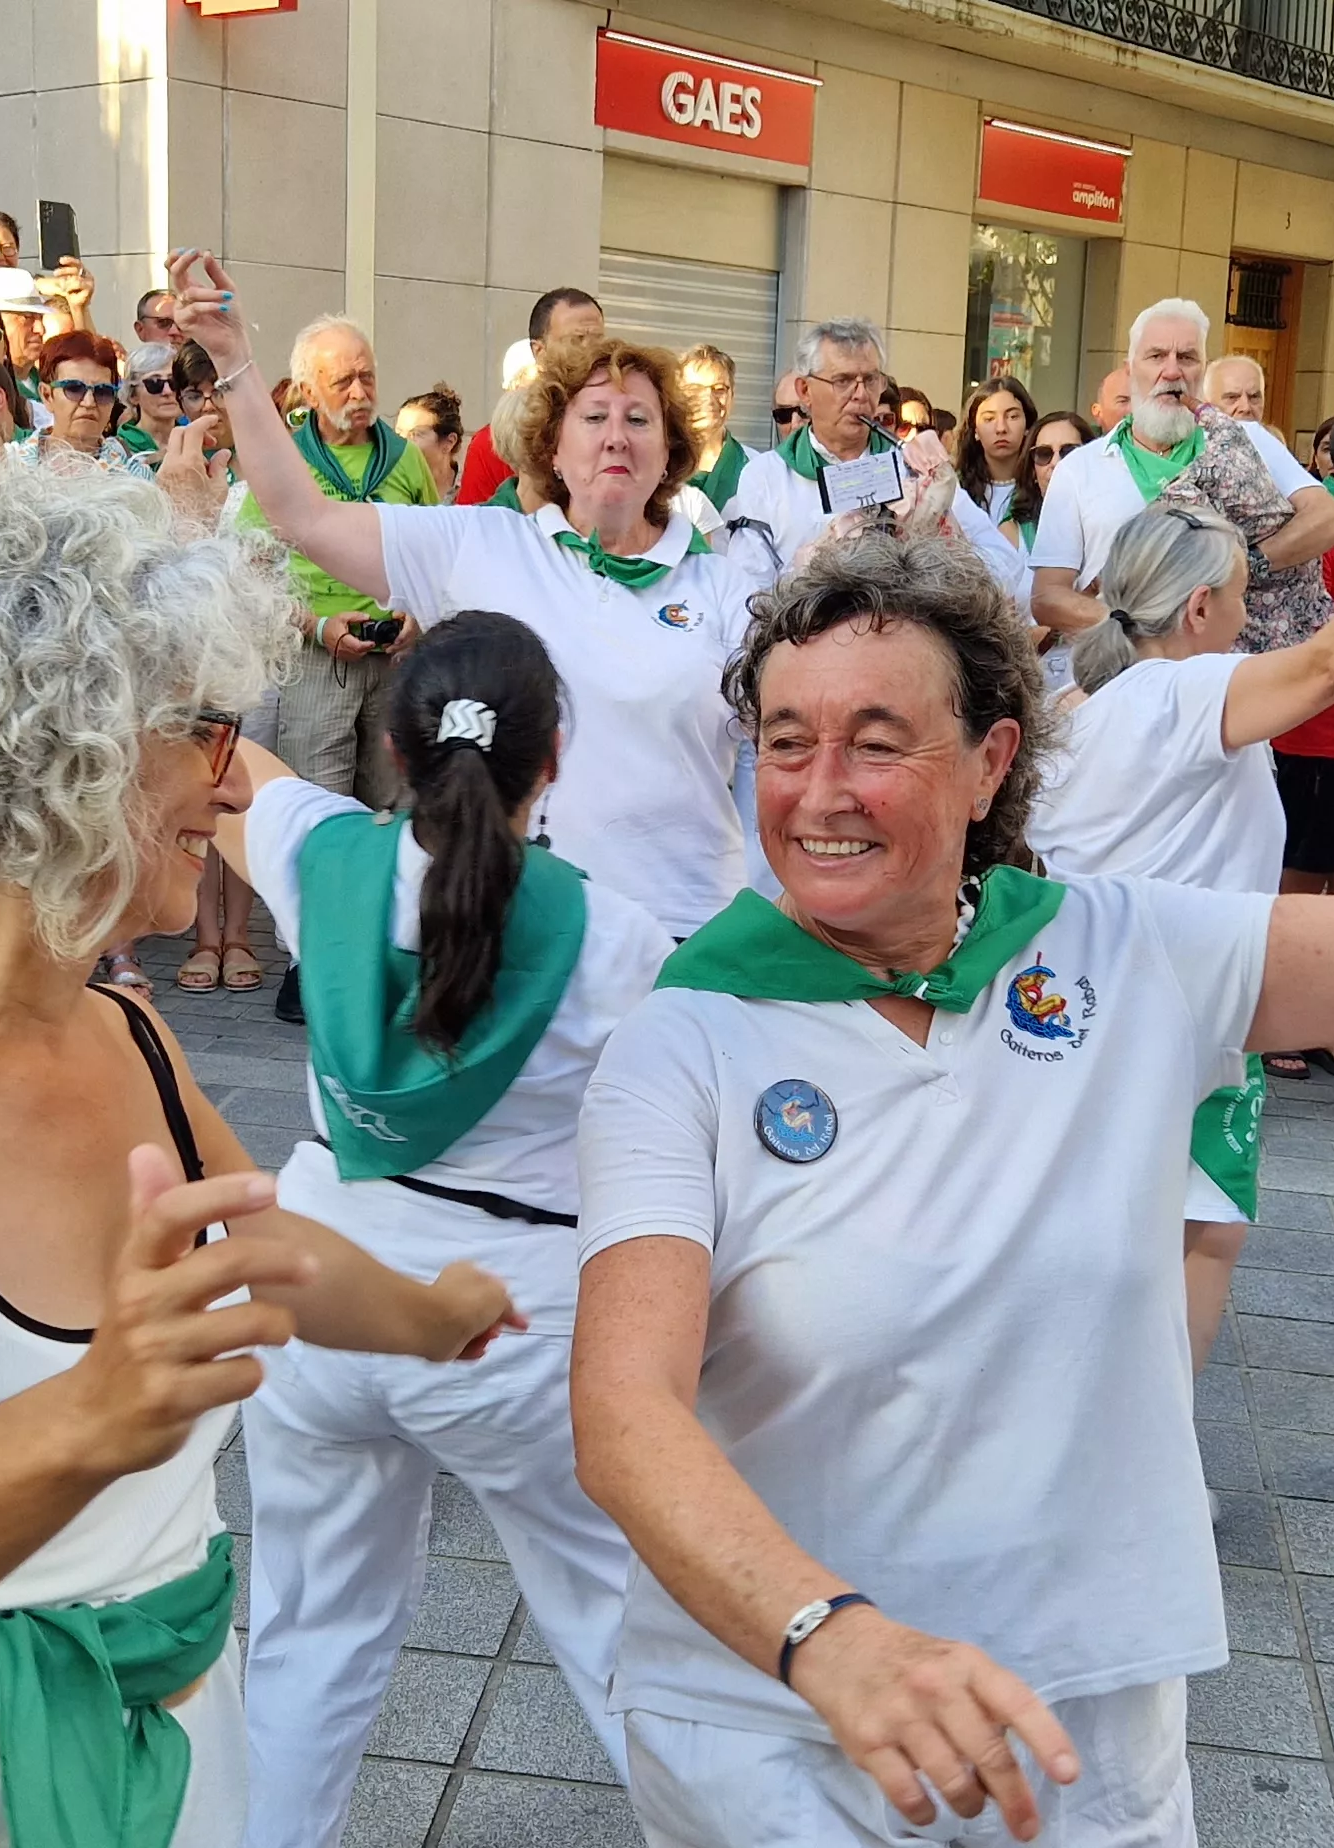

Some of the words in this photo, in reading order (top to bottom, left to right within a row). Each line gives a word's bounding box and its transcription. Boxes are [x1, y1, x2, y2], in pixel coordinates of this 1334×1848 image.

[662, 71, 762, 139] GAES
[1072, 190, 1115, 210] amplifon
[1074, 975, 1097, 1020] Rabal
[1000, 1028, 1064, 1062] Gaiteros
[1067, 1028, 1089, 1049] del
[764, 1126, 800, 1157] Gaiteros
[804, 1143, 821, 1156] del
[819, 1113, 833, 1144] Rabal
